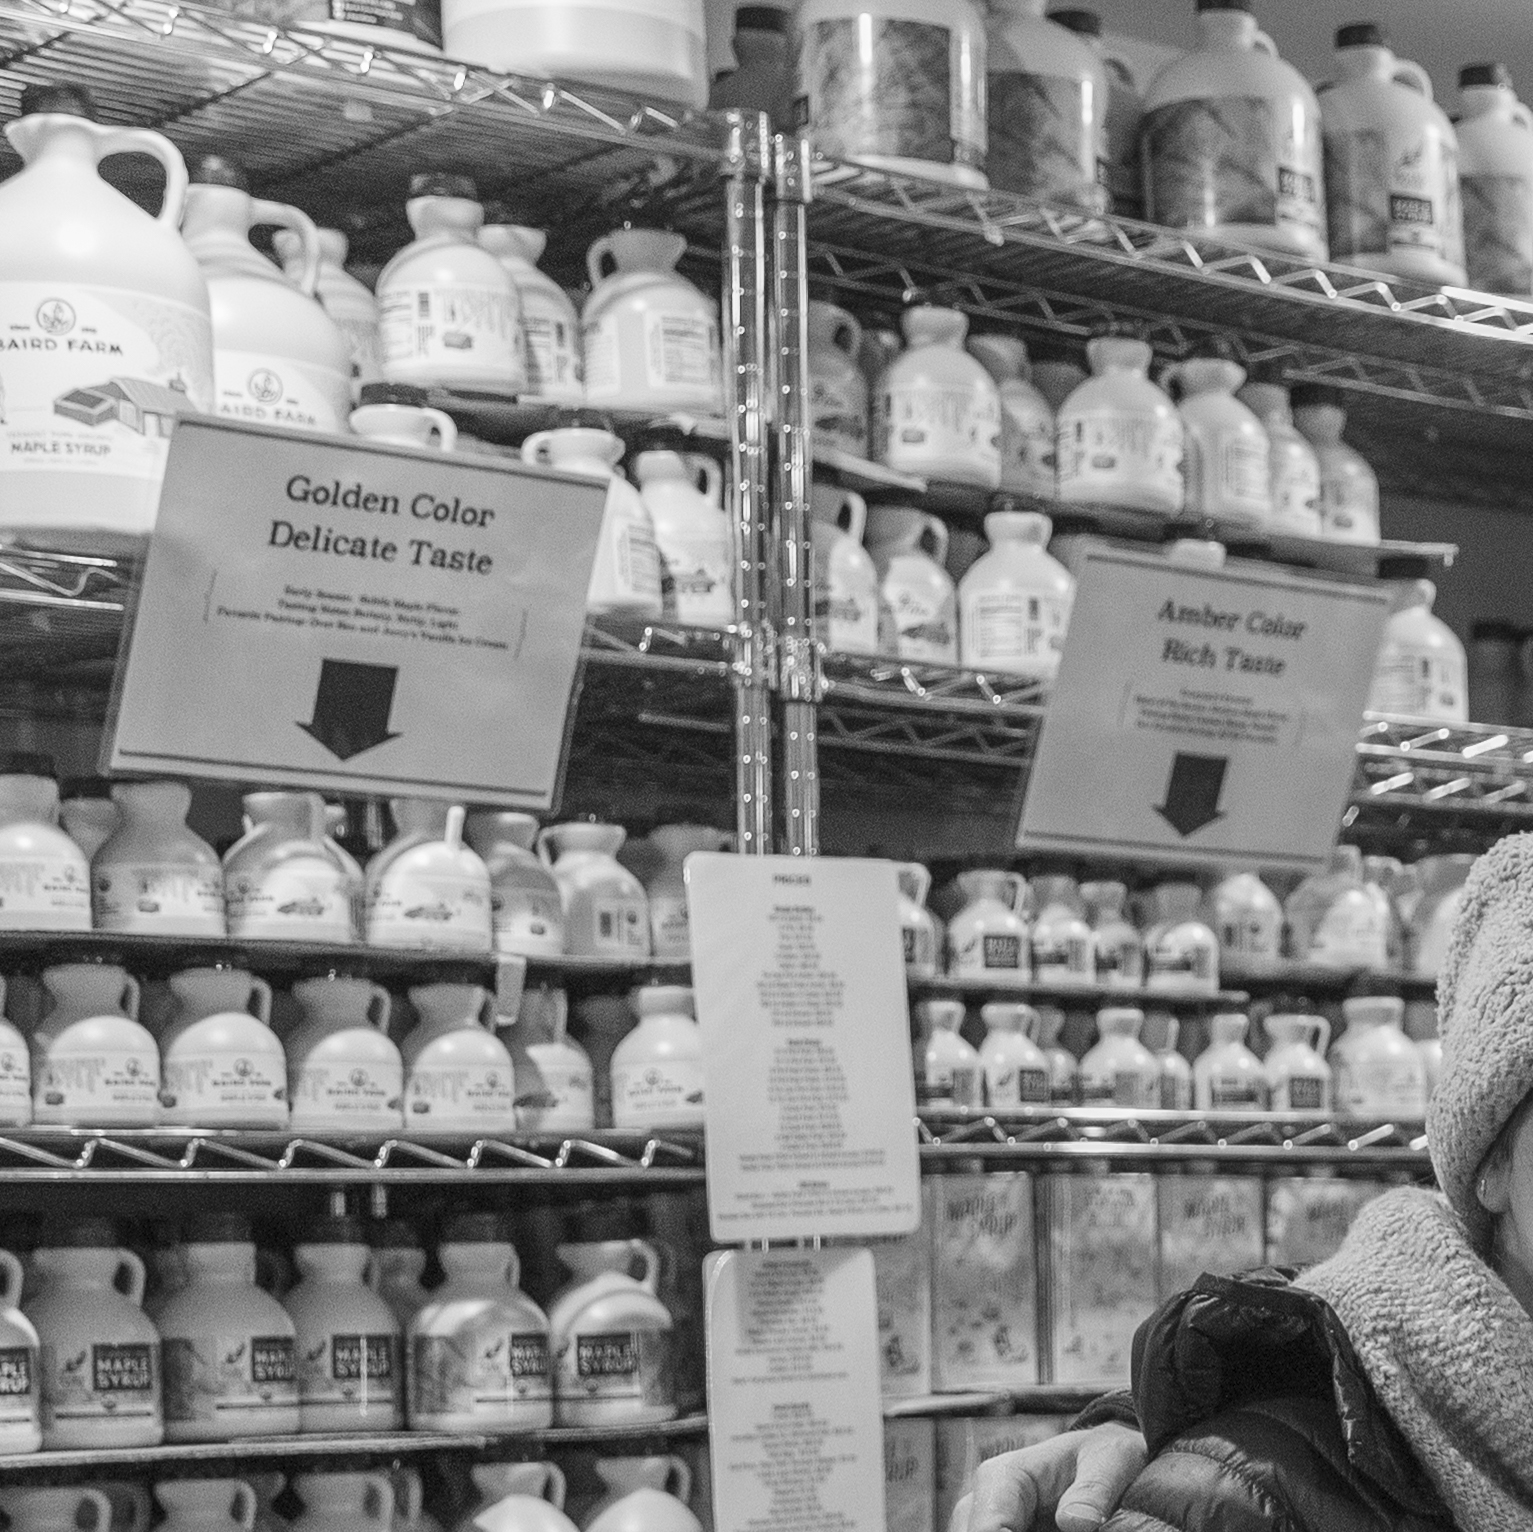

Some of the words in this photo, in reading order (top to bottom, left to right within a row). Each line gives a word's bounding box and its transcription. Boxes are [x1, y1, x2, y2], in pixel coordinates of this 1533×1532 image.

[67, 339, 124, 356] FARM
[11, 442, 60, 455] MAPLE
[65, 443, 111, 456] SYRUP
[286, 475, 400, 515] Golden
[410, 492, 495, 528] Color
[268, 519, 398, 562] Delicate
[408, 538, 494, 575] Taste
[1158, 598, 1241, 631] Amber
[1245, 611, 1307, 640] Color
[1163, 637, 1216, 668] Rich
[1226, 647, 1285, 678] Taste
[97, 1372, 148, 1387] SYRUP
[98, 1358, 148, 1373] MAPLE
